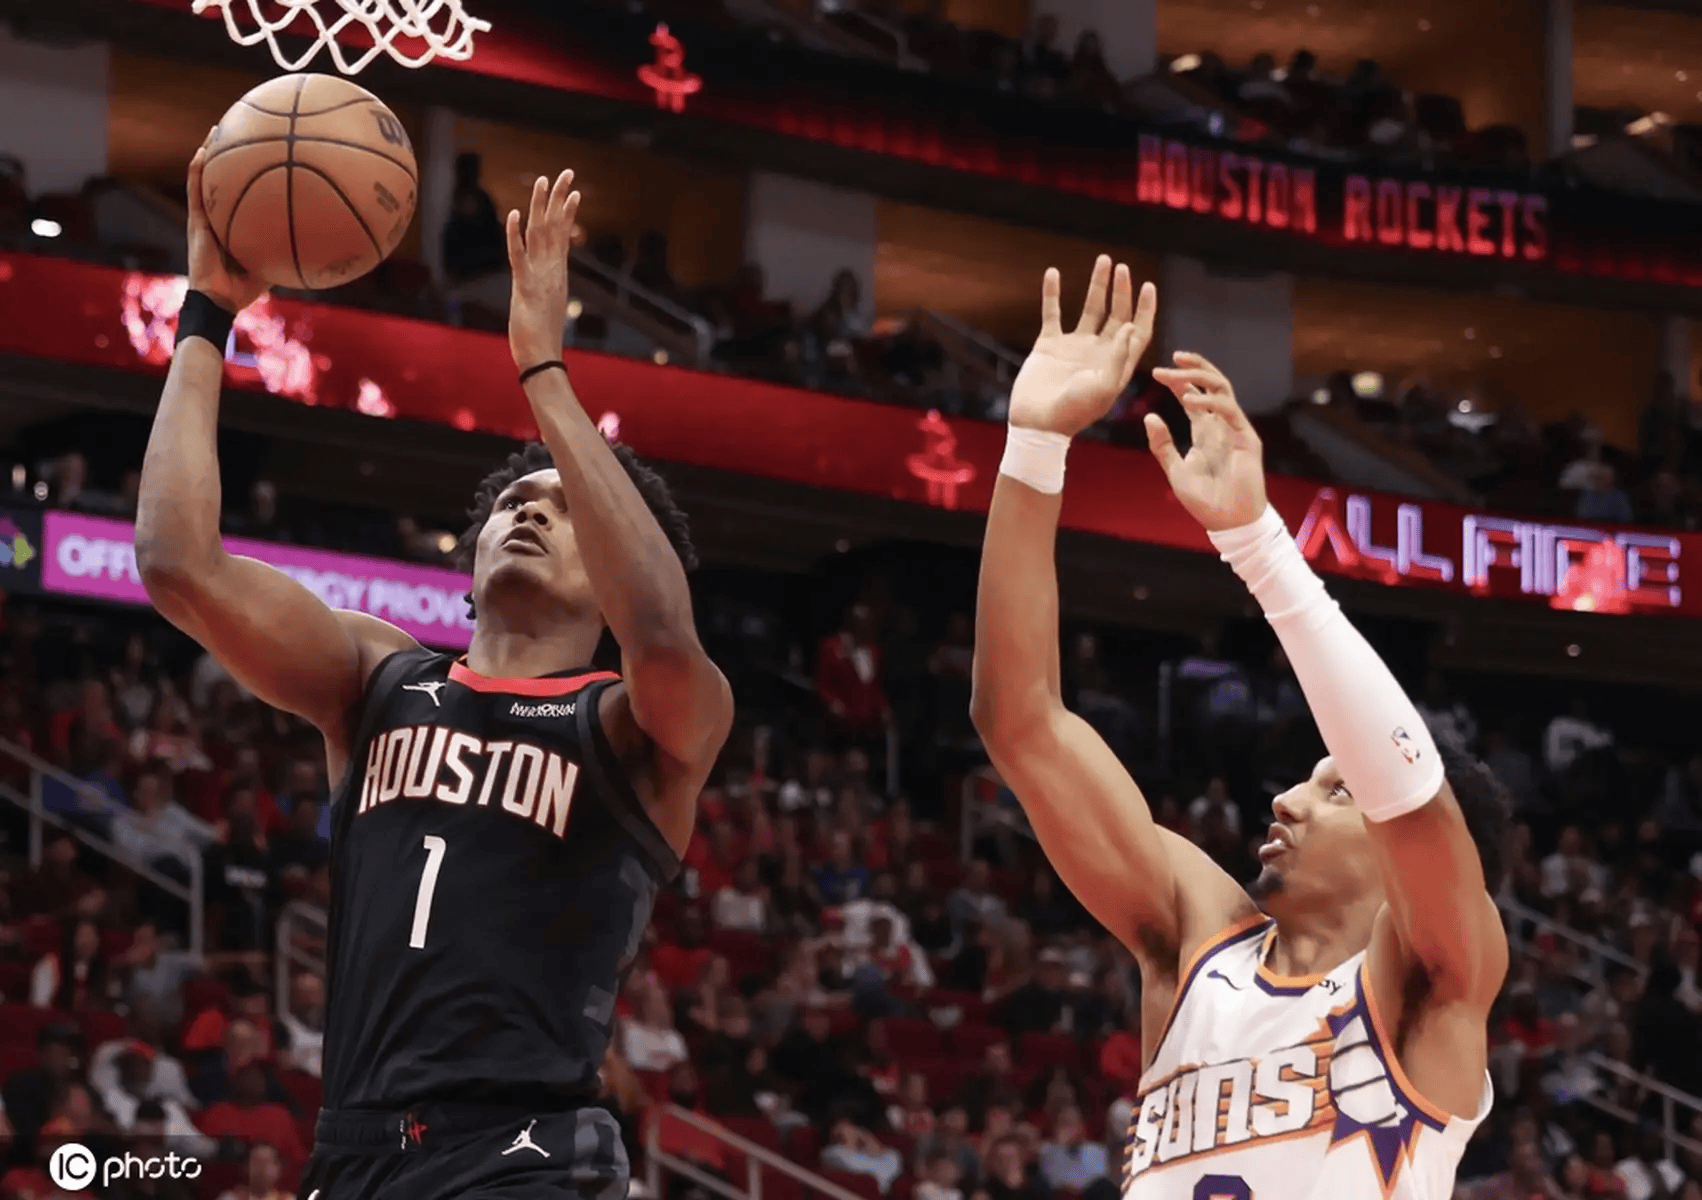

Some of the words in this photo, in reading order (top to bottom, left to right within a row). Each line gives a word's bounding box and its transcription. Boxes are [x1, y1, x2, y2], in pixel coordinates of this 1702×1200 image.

[1137, 133, 1317, 234] HOUSTON
[1343, 174, 1548, 260] ROCKETS
[358, 725, 579, 840] HOUSTON
[409, 834, 447, 949] 1
[1131, 1048, 1317, 1176] SUNS
